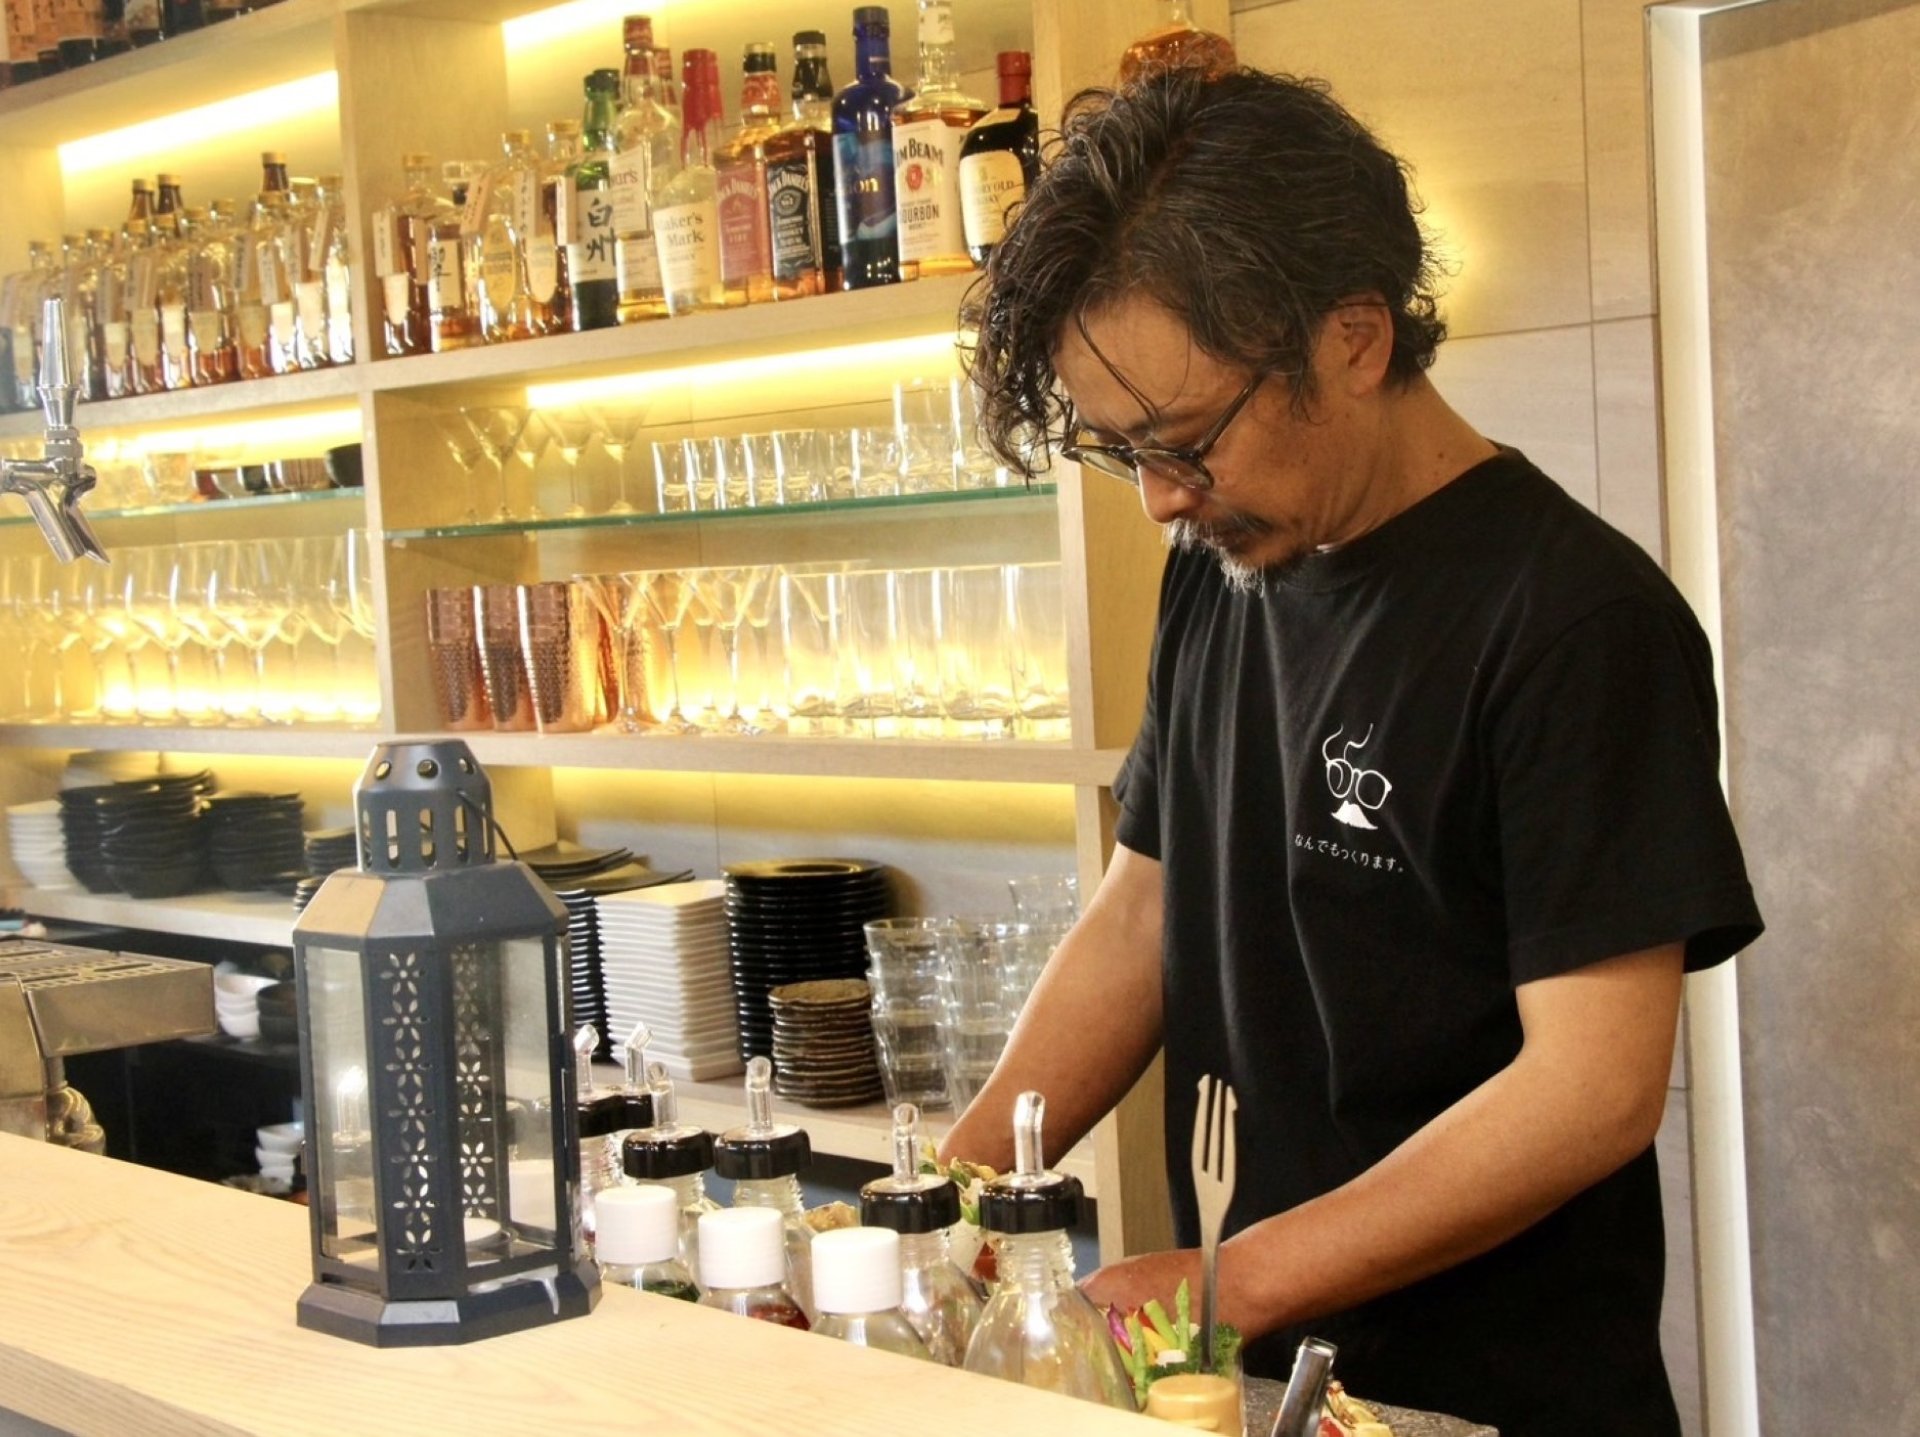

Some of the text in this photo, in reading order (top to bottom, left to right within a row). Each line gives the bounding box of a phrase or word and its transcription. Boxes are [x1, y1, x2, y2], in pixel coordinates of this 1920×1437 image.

[908, 137, 944, 167] BEAM
[586, 197, 617, 268] 白州
[666, 228, 706, 247] Mark
[1295, 834, 1403, 872] なんでもつくります。
